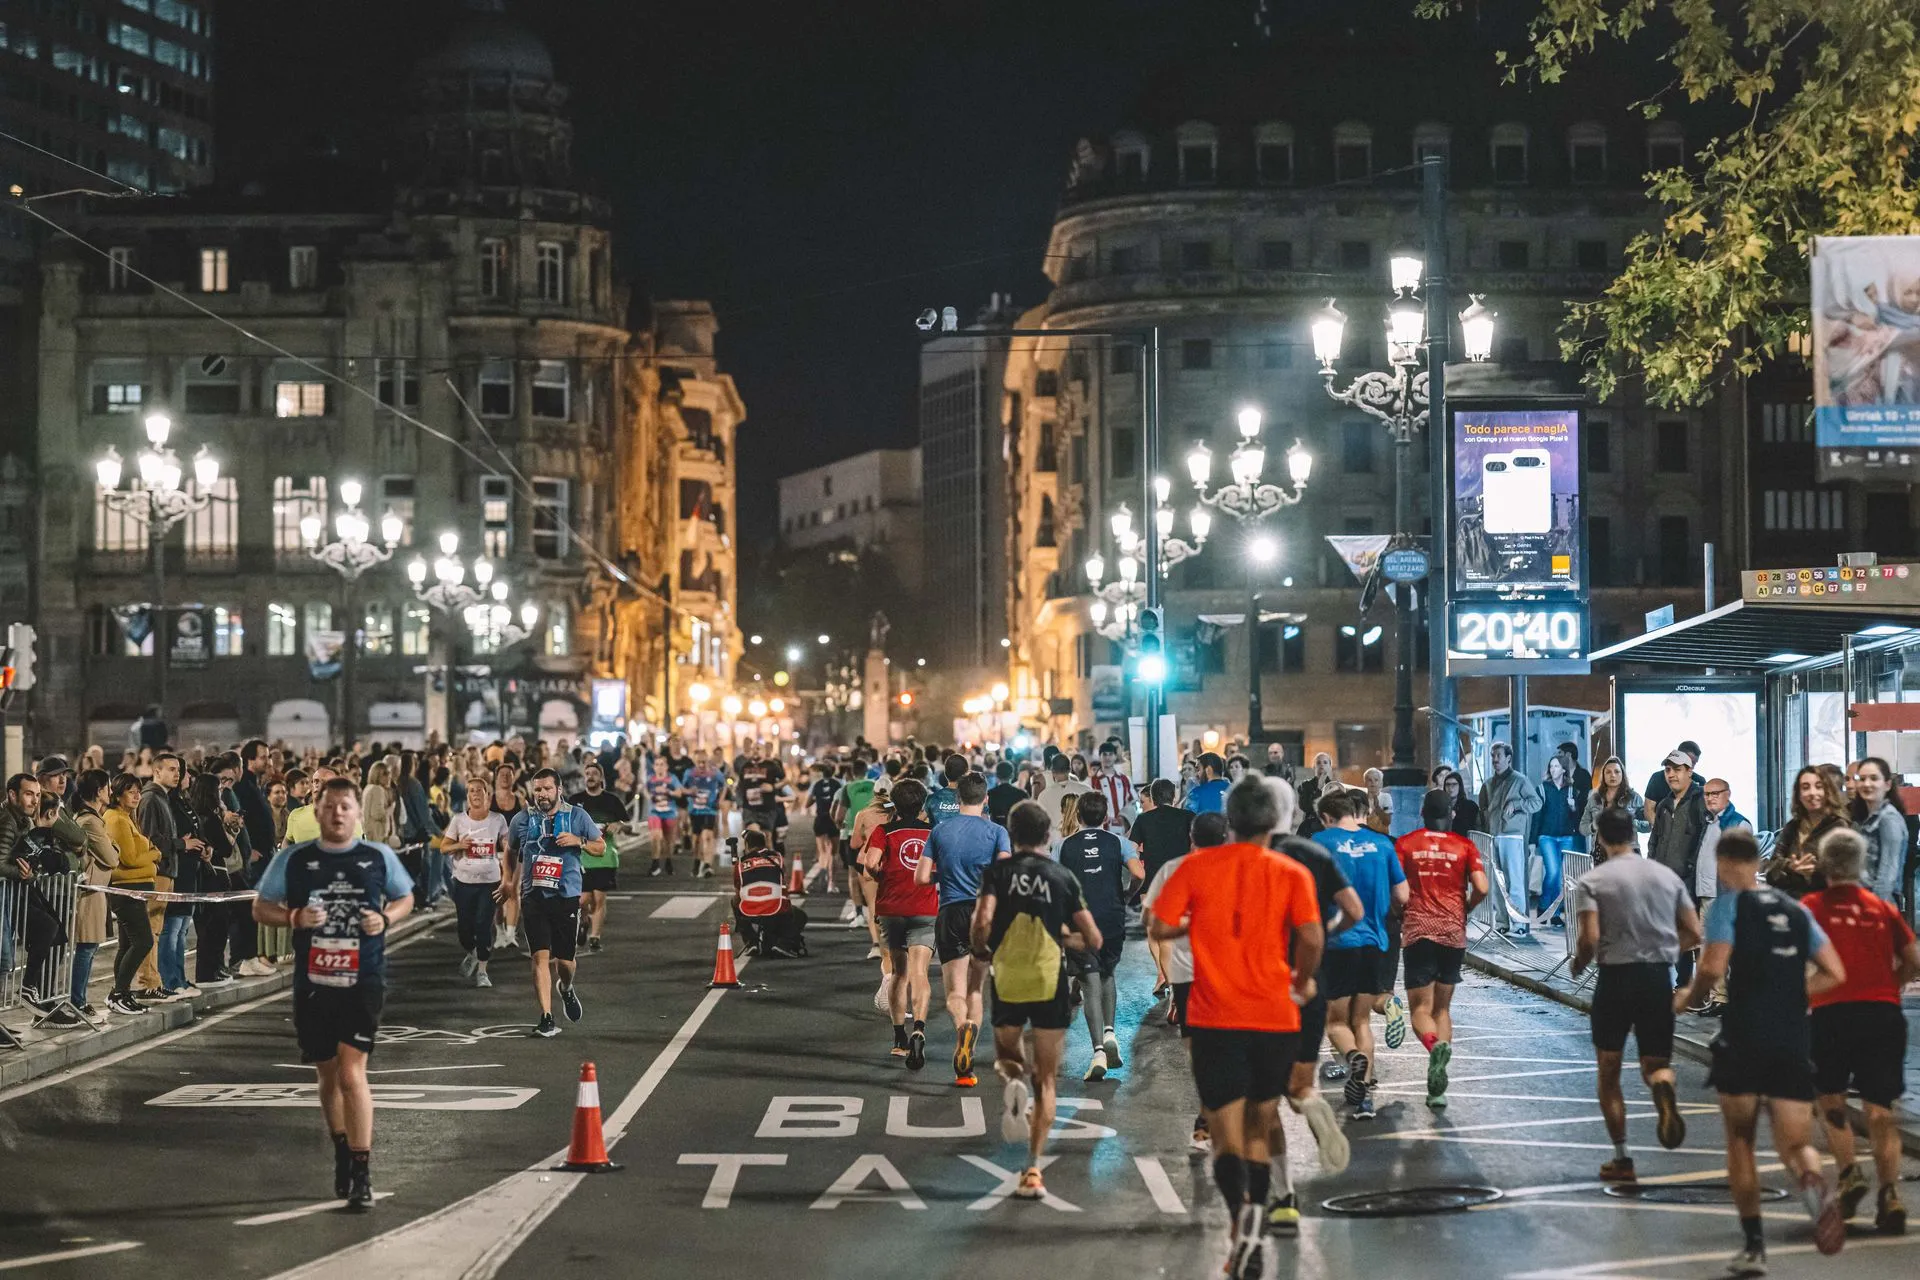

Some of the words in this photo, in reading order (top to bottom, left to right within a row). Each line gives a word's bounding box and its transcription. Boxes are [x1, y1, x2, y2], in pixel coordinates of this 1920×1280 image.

[1464, 425, 1490, 434] Todo
[1494, 426, 1530, 436] parece
[1533, 424, 1568, 435] magIA
[1757, 574, 1768, 582] 03
[1772, 573, 1781, 581] 28
[1786, 572, 1796, 581] 30
[1814, 571, 1823, 579] 56
[1856, 569, 1866, 577] 72
[1870, 568, 1880, 576] 75
[1884, 568, 1893, 576] 77
[1758, 587, 1768, 595] A1
[1786, 586, 1797, 594] A7
[1814, 585, 1824, 593] G4
[1828, 584, 1838, 592] G7
[1856, 583, 1867, 591] E7
[536, 865, 558, 875] 9747
[1007, 872, 1053, 904] ASM
[314, 953, 351, 968] 4922
[754, 1096, 1118, 1139] BUS
[675, 1153, 1189, 1215] TAXI
